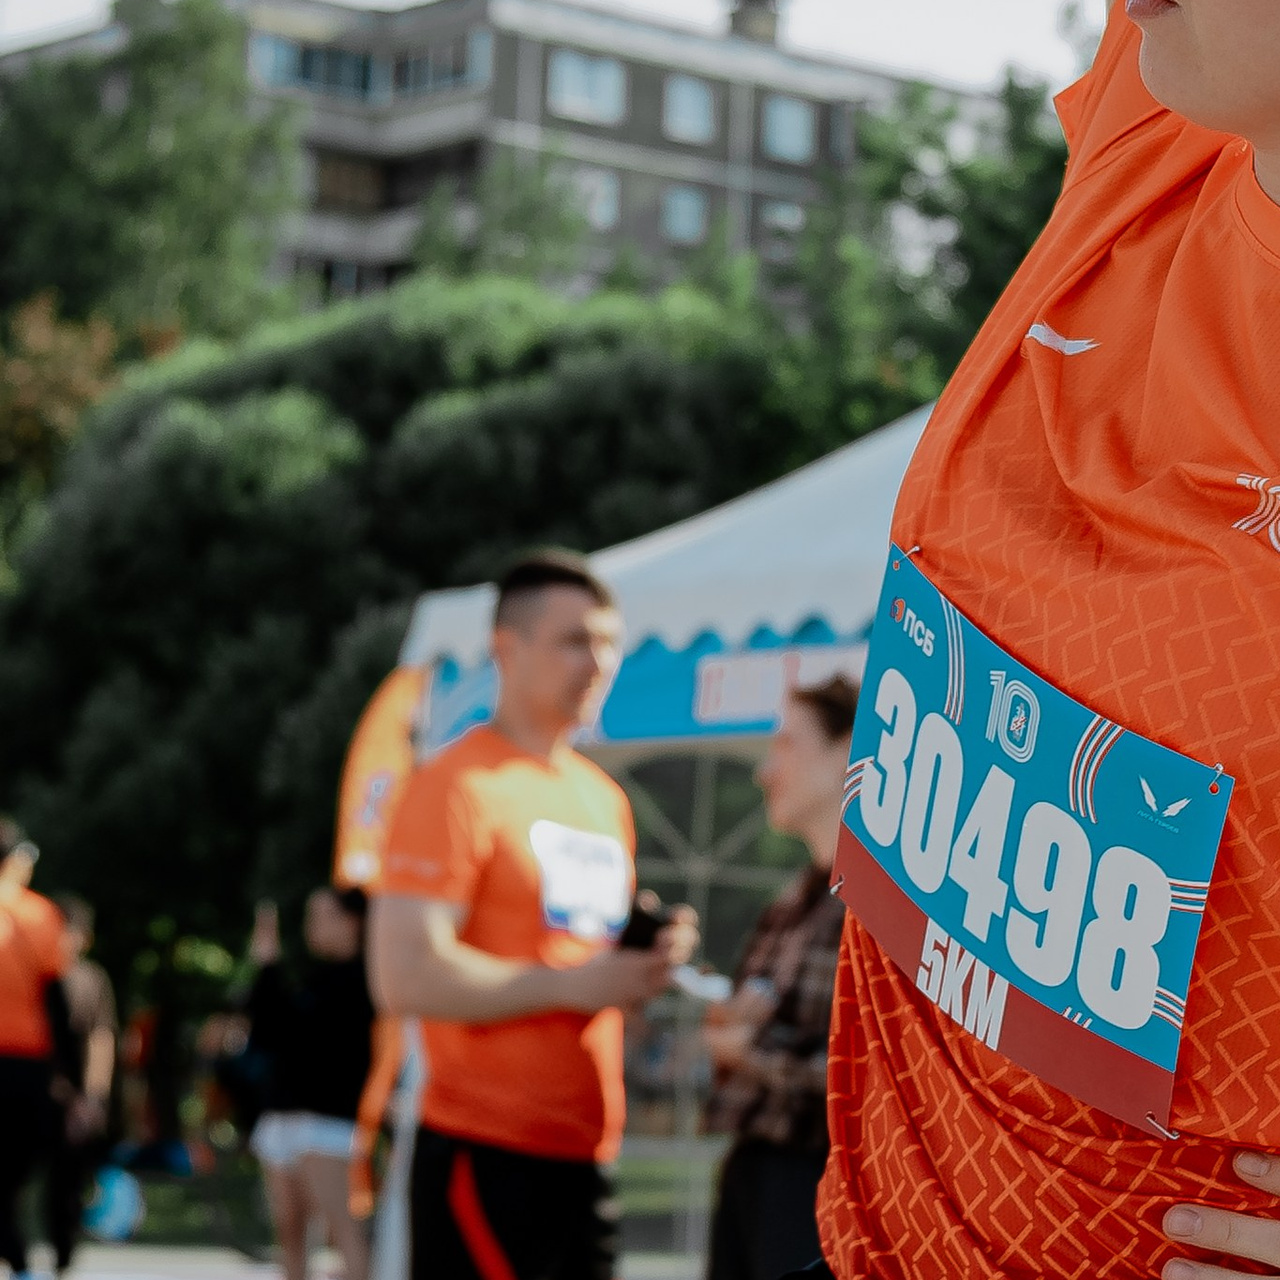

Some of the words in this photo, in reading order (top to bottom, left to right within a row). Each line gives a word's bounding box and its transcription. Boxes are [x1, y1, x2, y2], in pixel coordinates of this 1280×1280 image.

[903, 607, 936, 657] ПСБ
[985, 669, 1041, 763] 10
[859, 667, 1172, 1030] 30498
